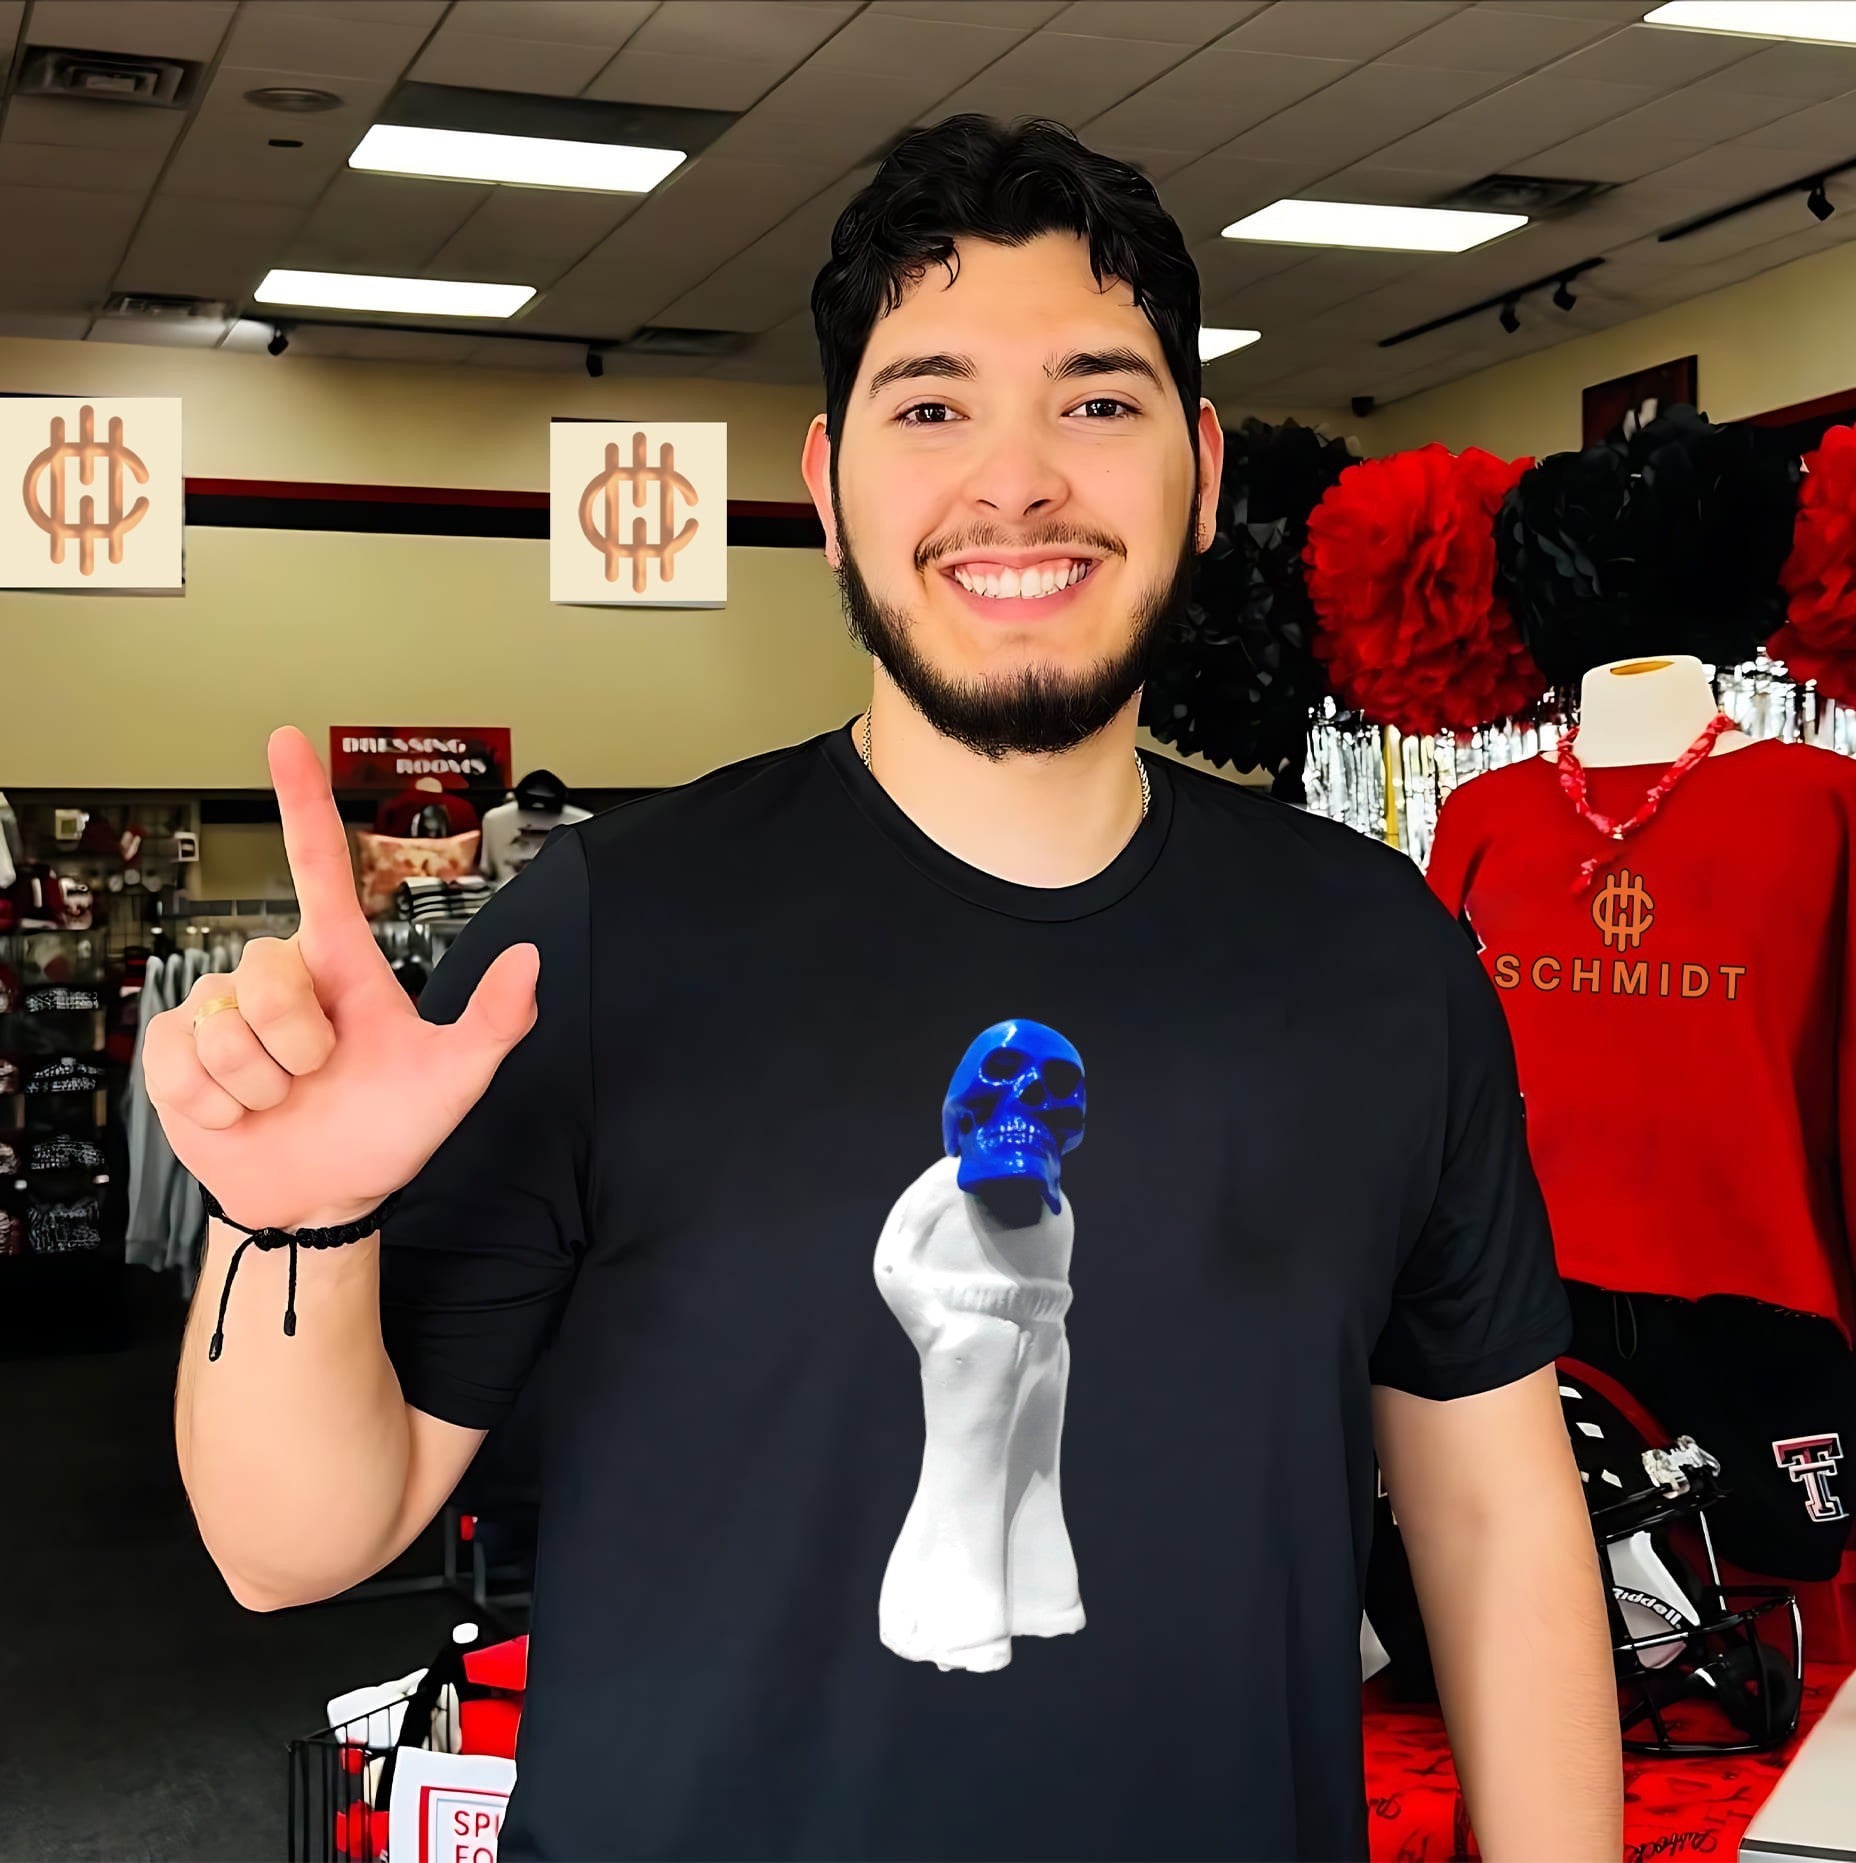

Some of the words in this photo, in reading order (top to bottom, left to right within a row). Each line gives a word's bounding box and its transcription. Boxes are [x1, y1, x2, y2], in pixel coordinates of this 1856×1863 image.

[342, 737, 466, 754] DRESSING
[396, 758, 487, 774] ROOMS
[1494, 953, 1747, 1000] SCHMIDT
